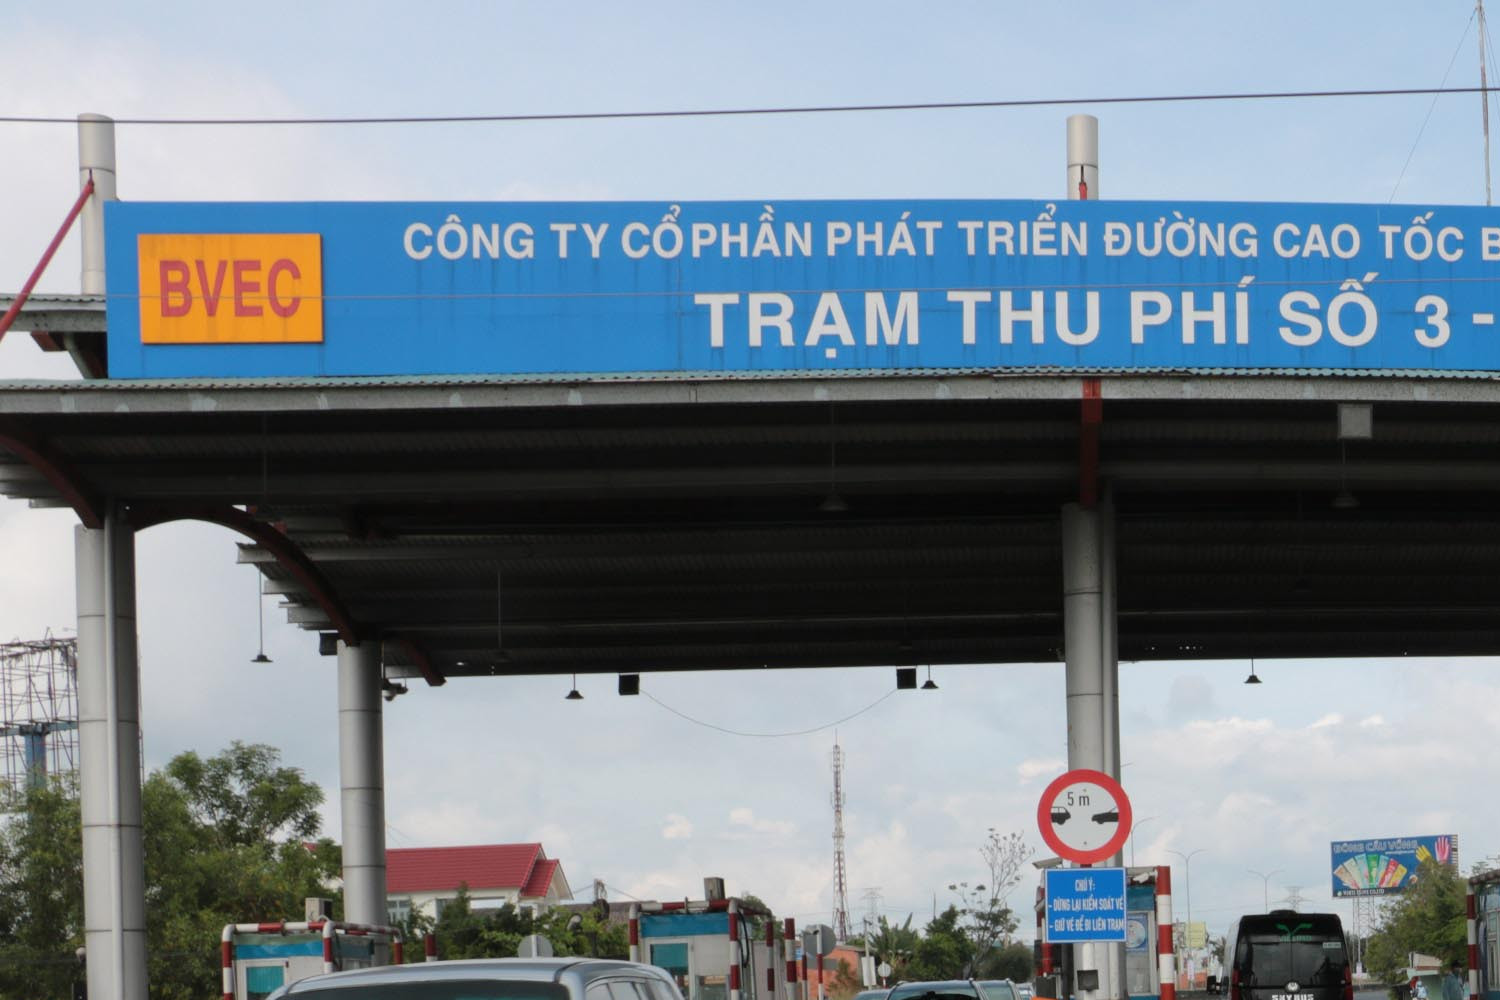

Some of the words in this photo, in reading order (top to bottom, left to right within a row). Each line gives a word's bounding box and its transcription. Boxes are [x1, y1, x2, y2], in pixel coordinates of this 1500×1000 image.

[404, 214, 533, 260] CÔNG
[550, 223, 609, 258] TY
[622, 204, 683, 259] CỔ
[692, 204, 812, 258] PHẦN
[828, 211, 943, 257] PHÁT
[958, 203, 1088, 256] TRIỂN
[1104, 211, 1258, 258] ĐƯỜNG
[1274, 222, 1361, 259] CAO
[1379, 211, 1464, 262] TỐC
[159, 258, 302, 318] BVEC
[694, 291, 919, 359] TRẠM
[947, 290, 1100, 346] THU
[1131, 275, 1255, 345] PHÍ
[1280, 272, 1379, 347] SỐ
[1414, 295, 1451, 348] 3
[1067, 791, 1074, 806] 5
[1079, 795, 1090, 806] m
[1074, 877, 1088, 892] CHÚ
